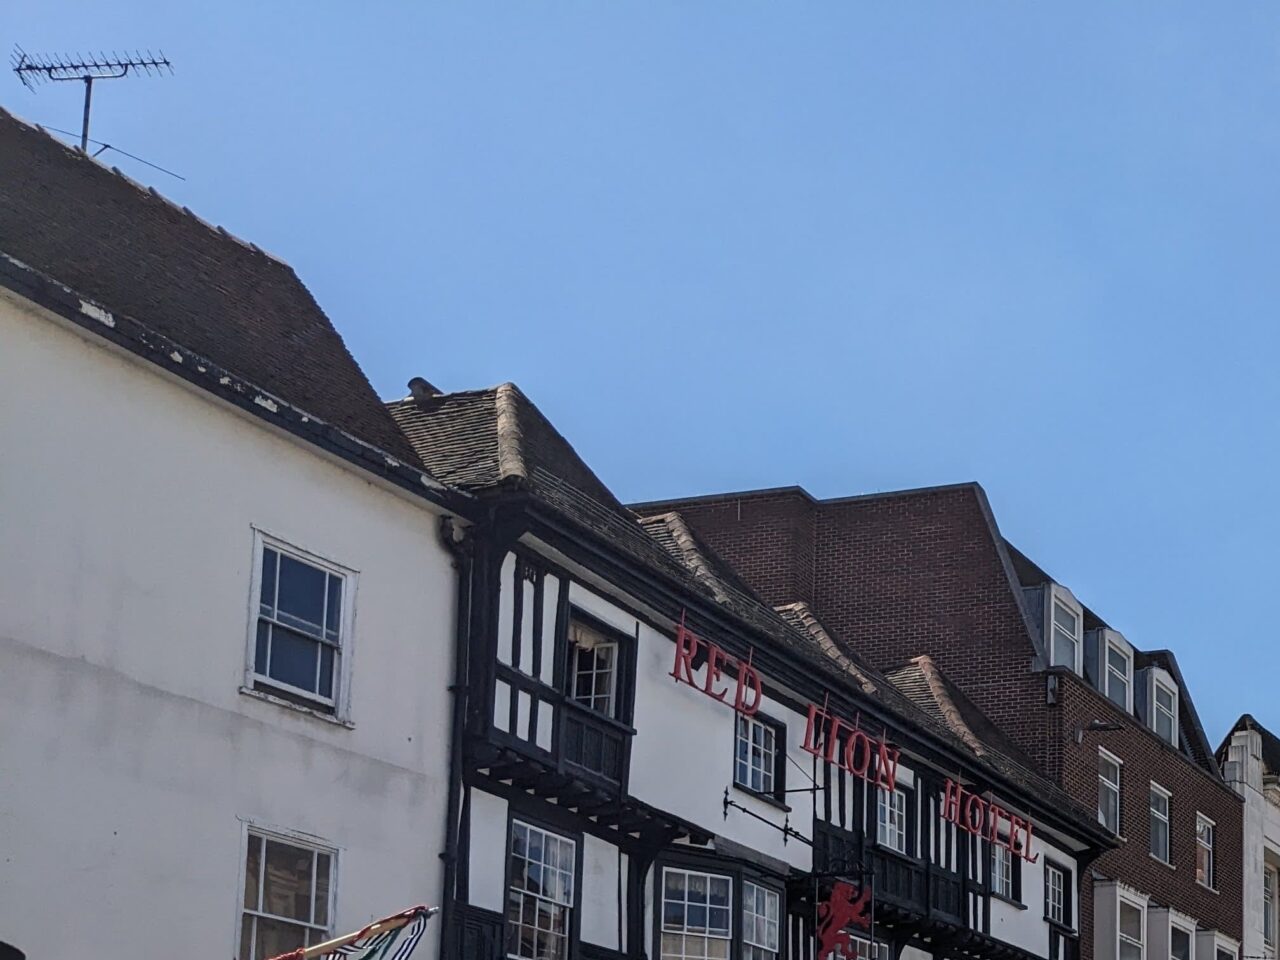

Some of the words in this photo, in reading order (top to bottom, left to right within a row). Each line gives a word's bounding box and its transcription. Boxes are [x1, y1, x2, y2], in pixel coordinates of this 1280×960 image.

[669, 624, 762, 716] RED
[800, 704, 900, 792] LION
[941, 778, 1039, 864] HOTEL
